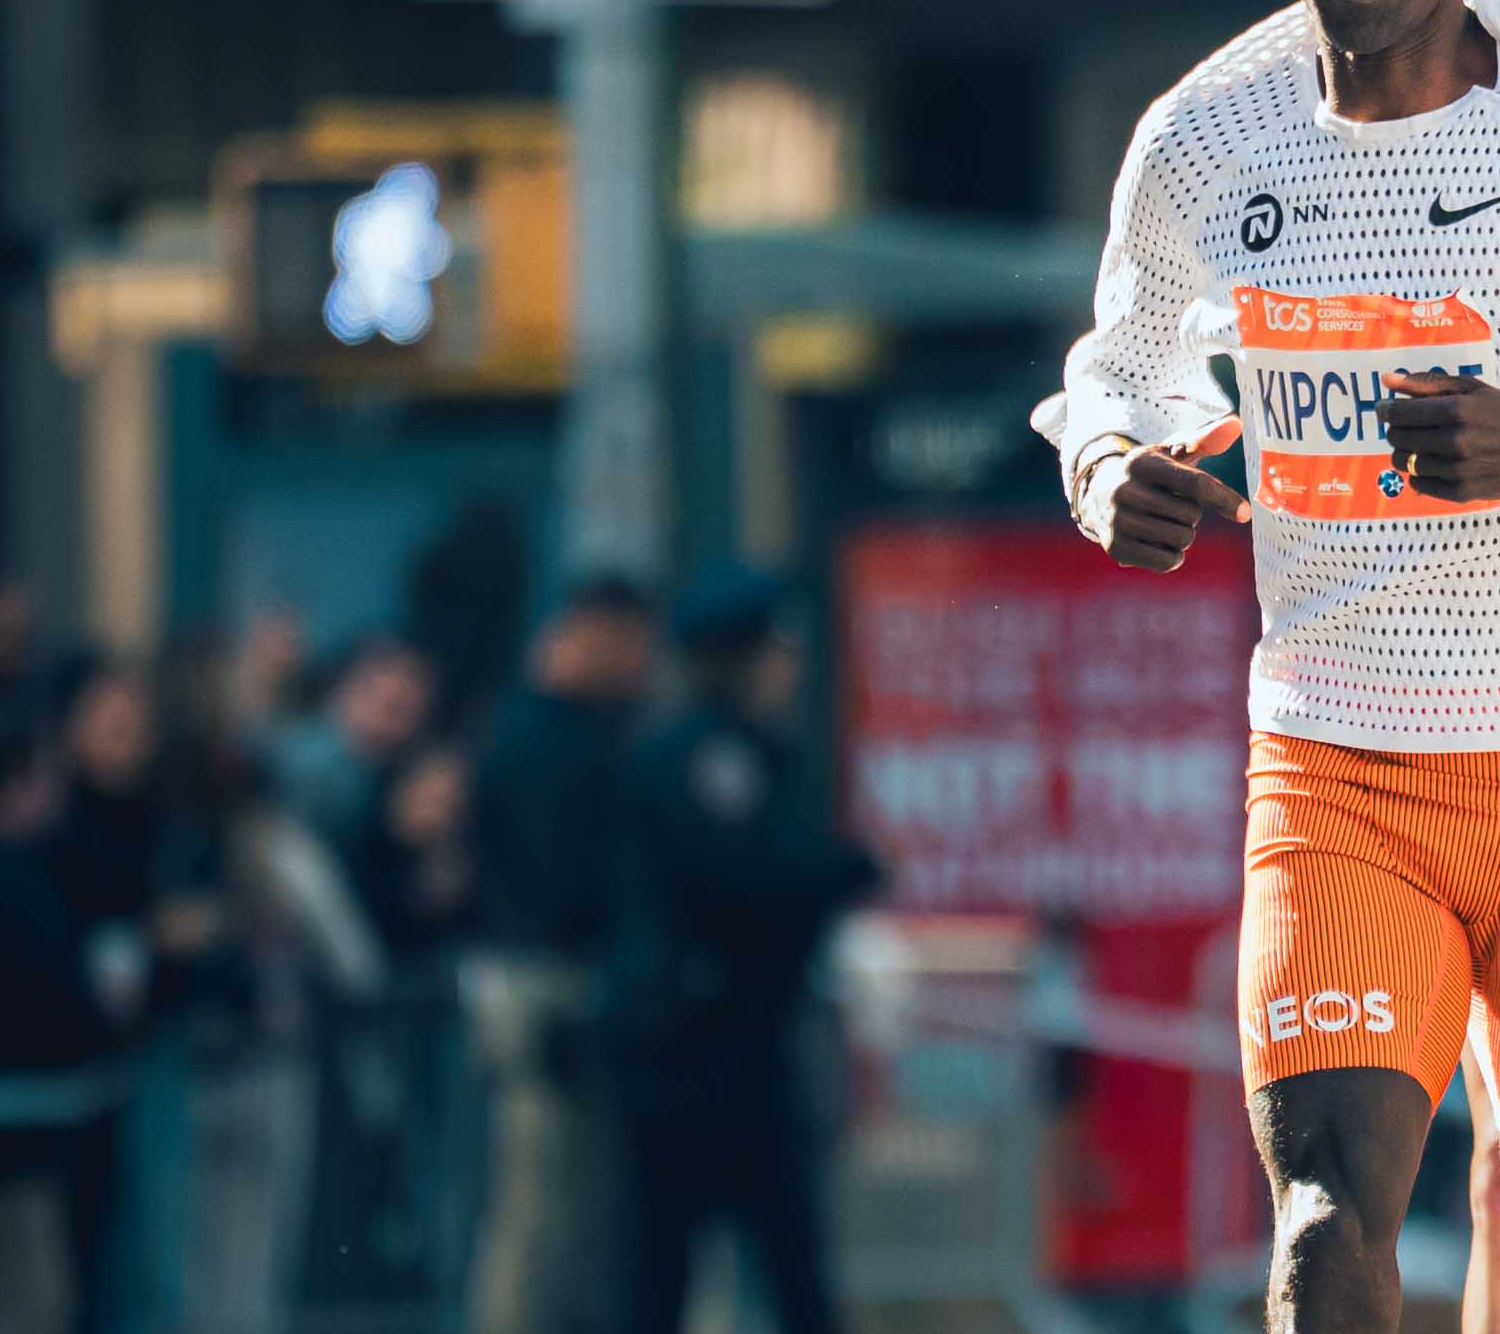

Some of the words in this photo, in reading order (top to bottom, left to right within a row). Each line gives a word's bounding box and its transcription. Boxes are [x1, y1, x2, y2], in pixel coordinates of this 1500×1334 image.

[1293, 204, 1328, 224] NN
[1317, 320, 1365, 332] SERVICES
[1257, 363, 1483, 443] KIPCH
